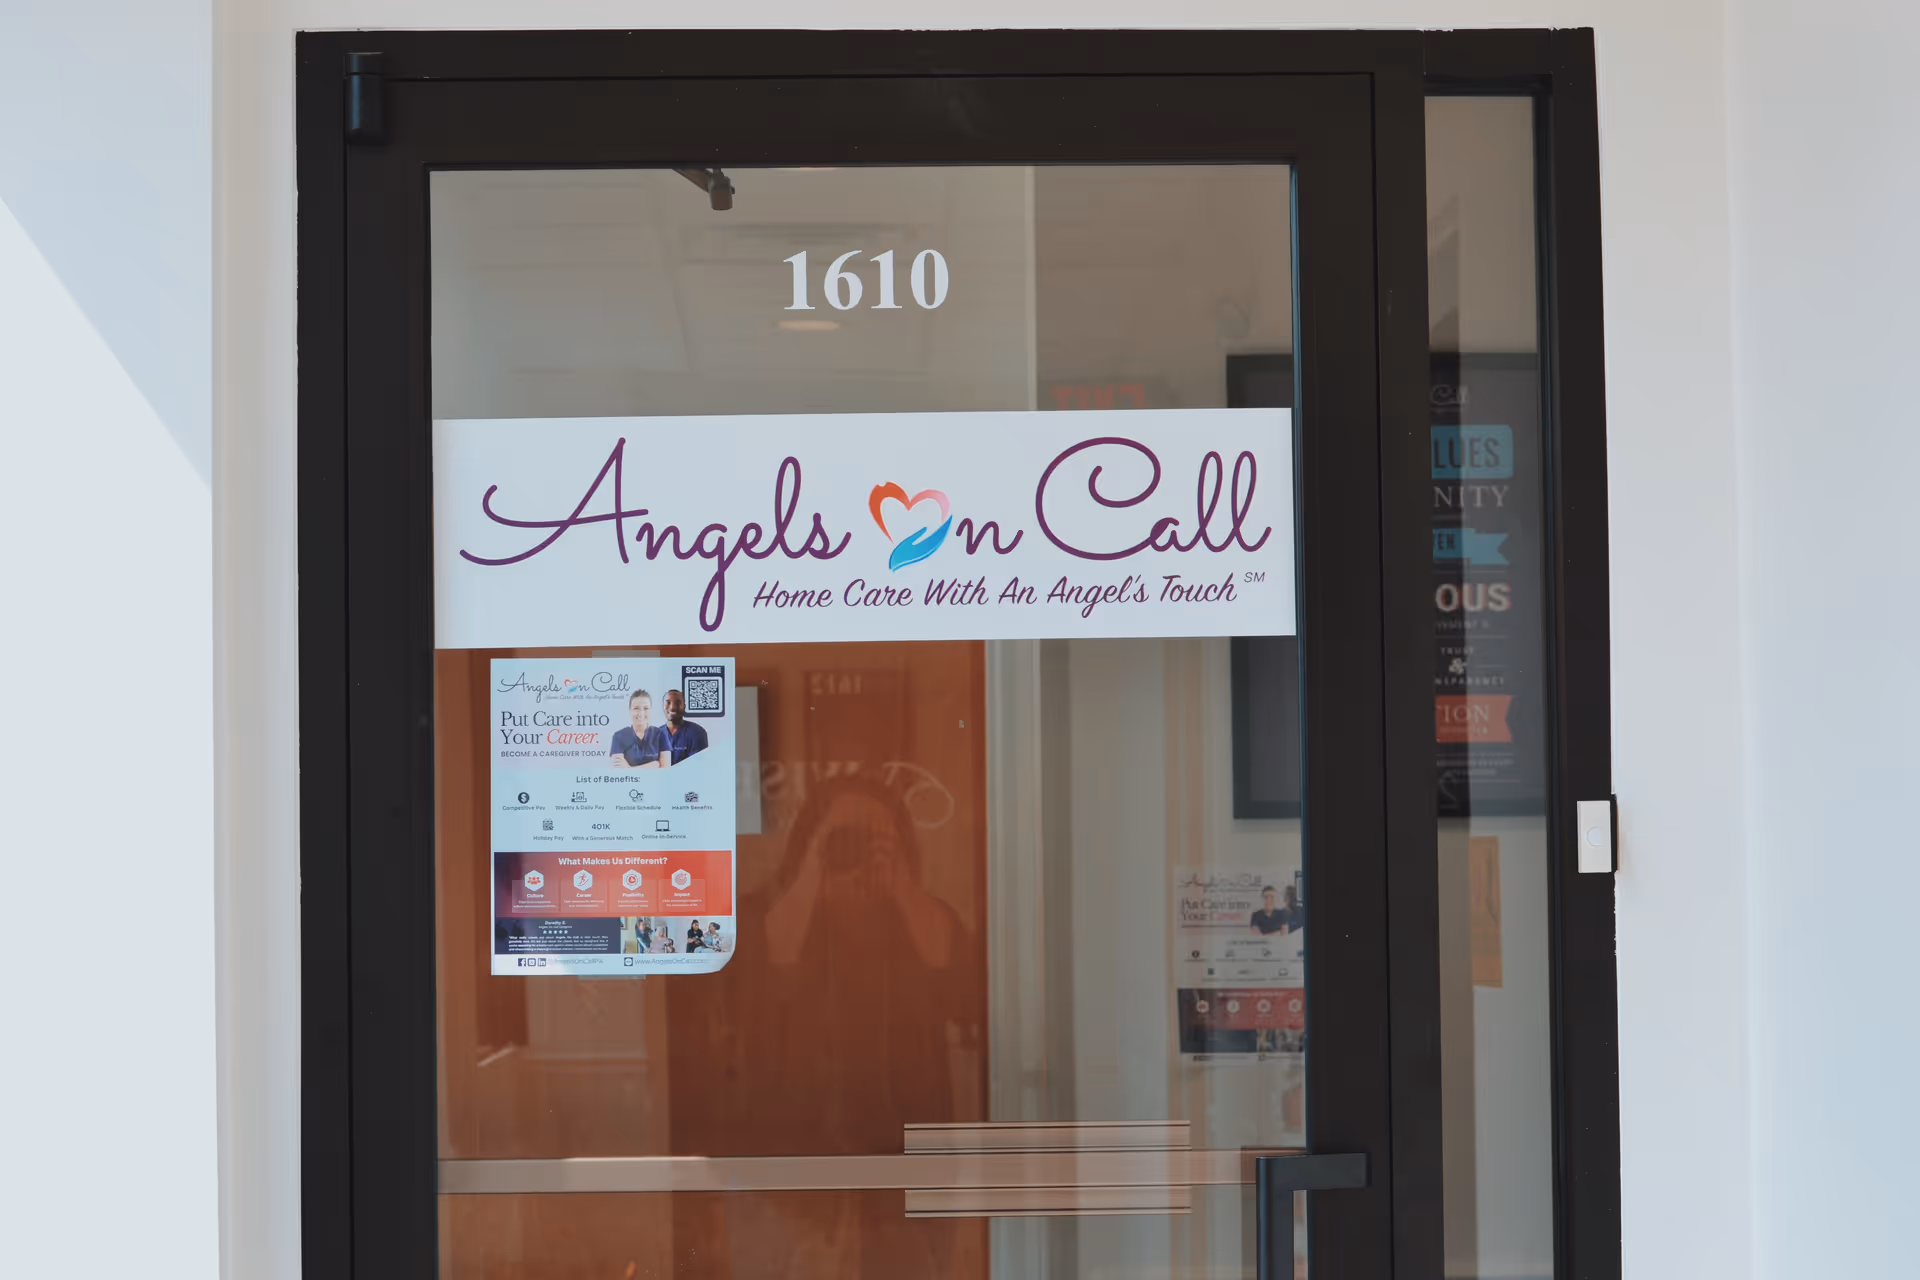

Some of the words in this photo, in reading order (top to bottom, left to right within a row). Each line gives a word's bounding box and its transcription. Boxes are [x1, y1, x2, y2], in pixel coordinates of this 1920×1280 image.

[783, 249, 949, 310] 1610
[1433, 438, 1499, 469] LUES
[1433, 485, 1509, 508] NITY
[460, 437, 851, 633] Angels
[1035, 436, 1271, 562] Call
[752, 580, 834, 609] Home
[843, 578, 914, 607] Care
[923, 575, 990, 606] With
[998, 576, 1038, 605] An
[1046, 573, 1150, 619] Angel's
[1159, 572, 1238, 603] Touch
[1243, 571, 1266, 584] SM
[1435, 583, 1512, 612] OUS
[685, 666, 707, 674] SCAN
[708, 666, 722, 674] ME
[497, 672, 562, 703] Angels
[591, 672, 631, 692] Call
[500, 710, 528, 727] Put
[532, 710, 573, 727] Care
[576, 710, 610, 727] into
[500, 728, 543, 745] Your
[546, 728, 600, 745] Career.
[500, 750, 531, 758] BECOME
[575, 775, 592, 784] List
[593, 775, 602, 784] of
[603, 775, 641, 784] Benefits:
[591, 823, 611, 831] 401K
[558, 857, 581, 866] What
[582, 857, 610, 865] Makes
[612, 857, 623, 865] Us
[624, 857, 668, 866] Different?
